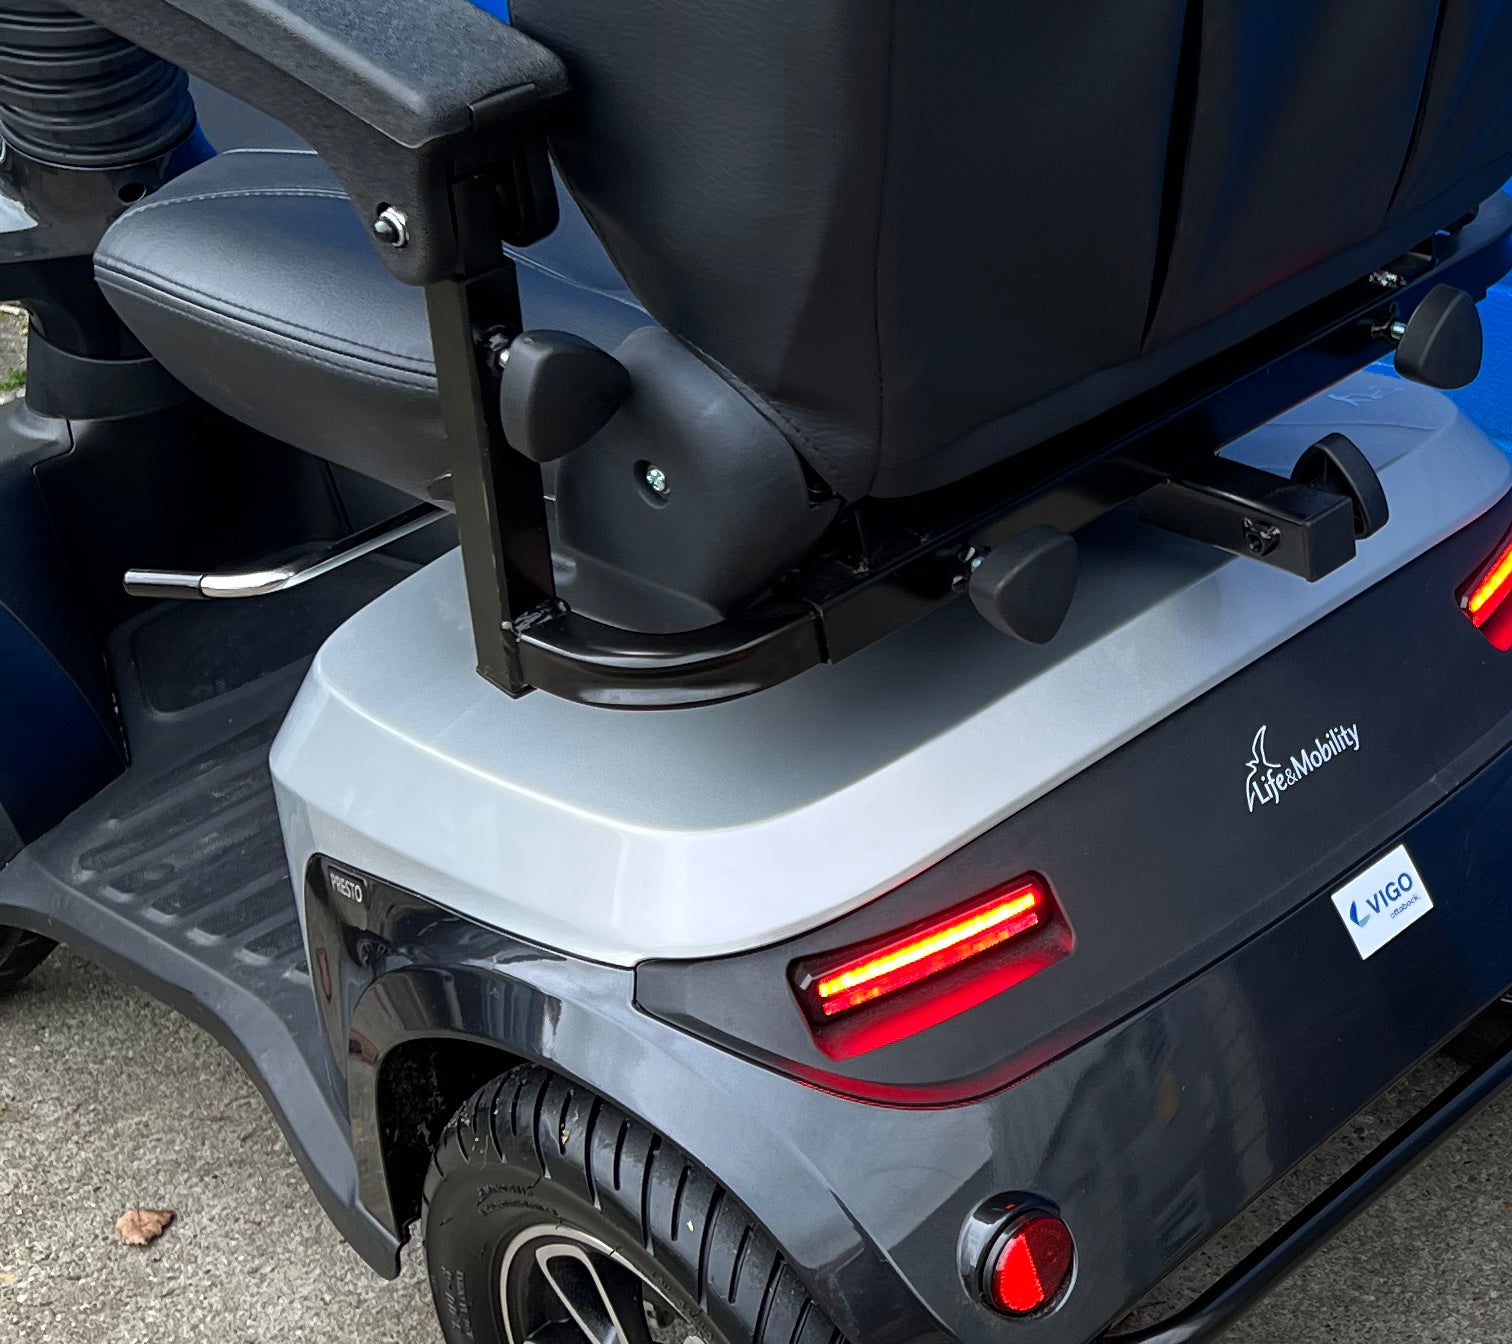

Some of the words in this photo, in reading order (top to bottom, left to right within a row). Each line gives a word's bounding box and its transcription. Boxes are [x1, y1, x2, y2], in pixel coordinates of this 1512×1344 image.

[1252, 723, 1360, 804] Life&Mobility
[330, 872, 363, 903] PRESTO
[1365, 872, 1413, 914] VIGO
